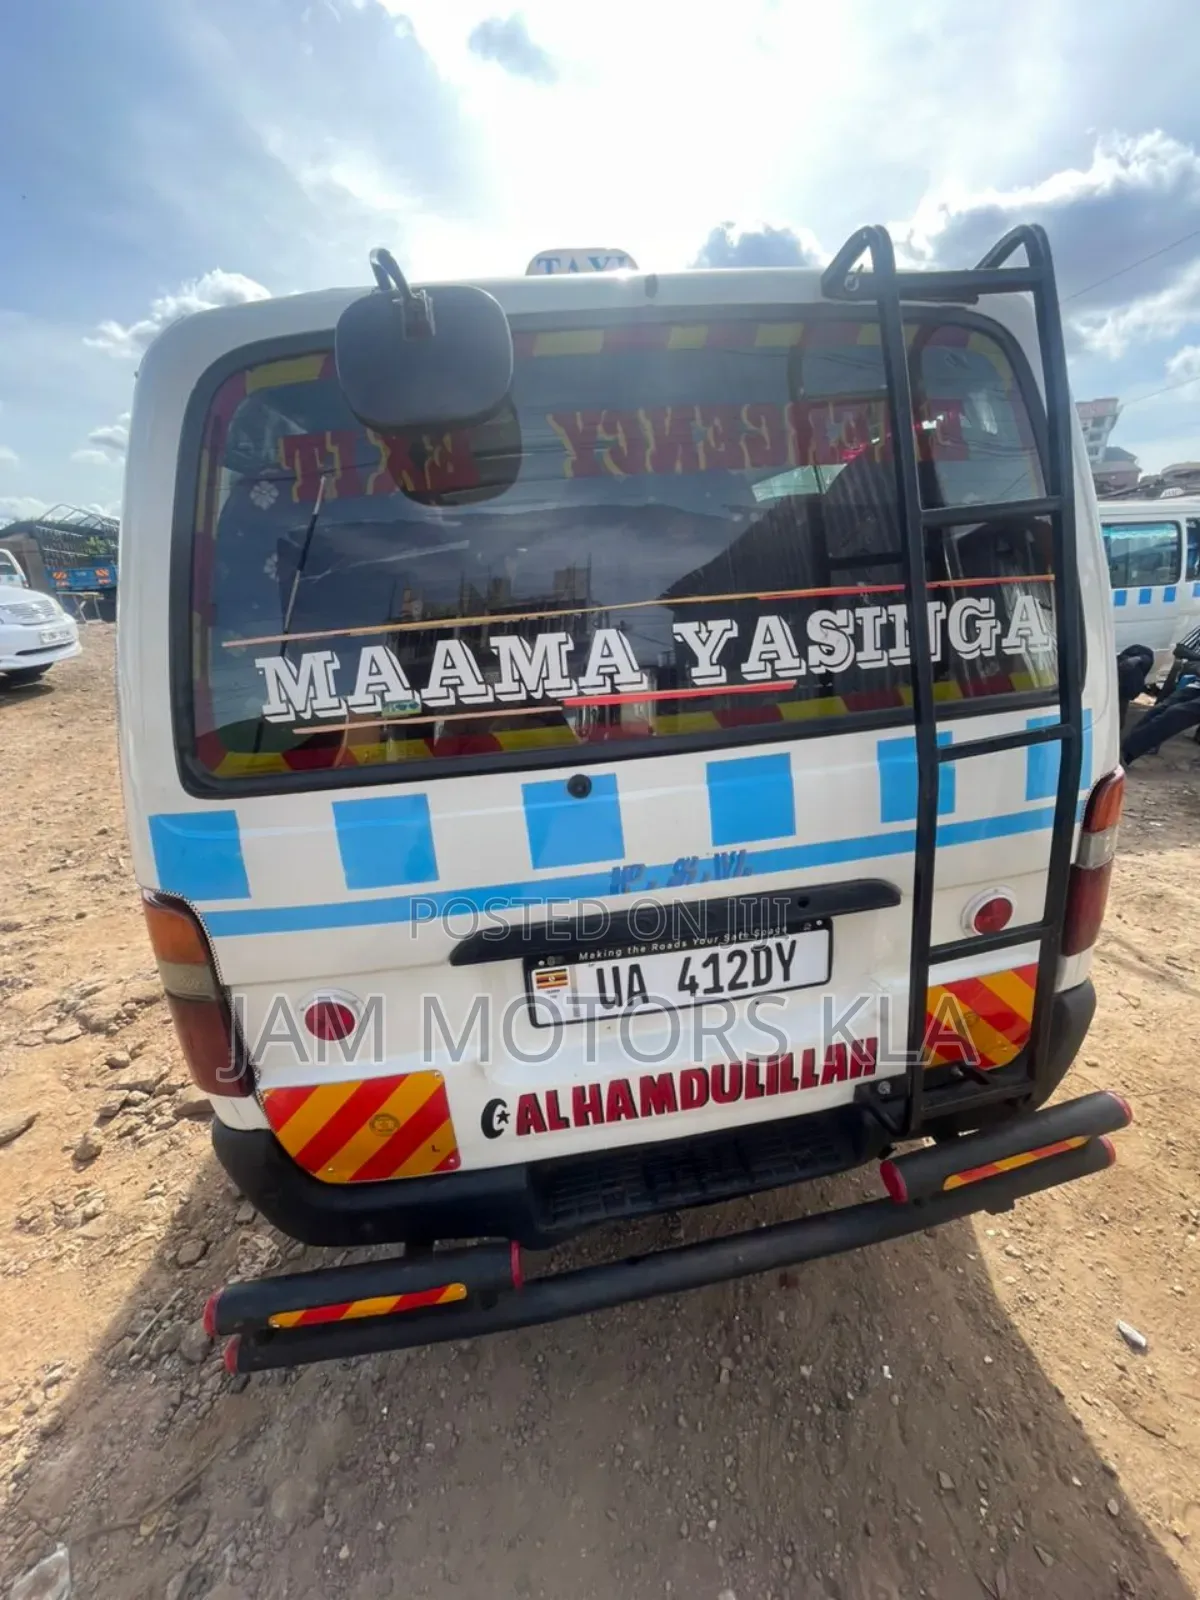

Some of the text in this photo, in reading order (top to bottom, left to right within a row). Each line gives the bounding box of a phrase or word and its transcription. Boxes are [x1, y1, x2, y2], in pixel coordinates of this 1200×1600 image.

[255, 594, 1055, 723] MAAMA YASINGA
[578, 947, 623, 961] Making
[627, 944, 647, 954] the
[651, 939, 688, 951] Roads
[692, 935, 719, 946] Your
[596, 939, 797, 1010] UA 412DY
[516, 1036, 879, 1136] ALHAMDULILLAH
